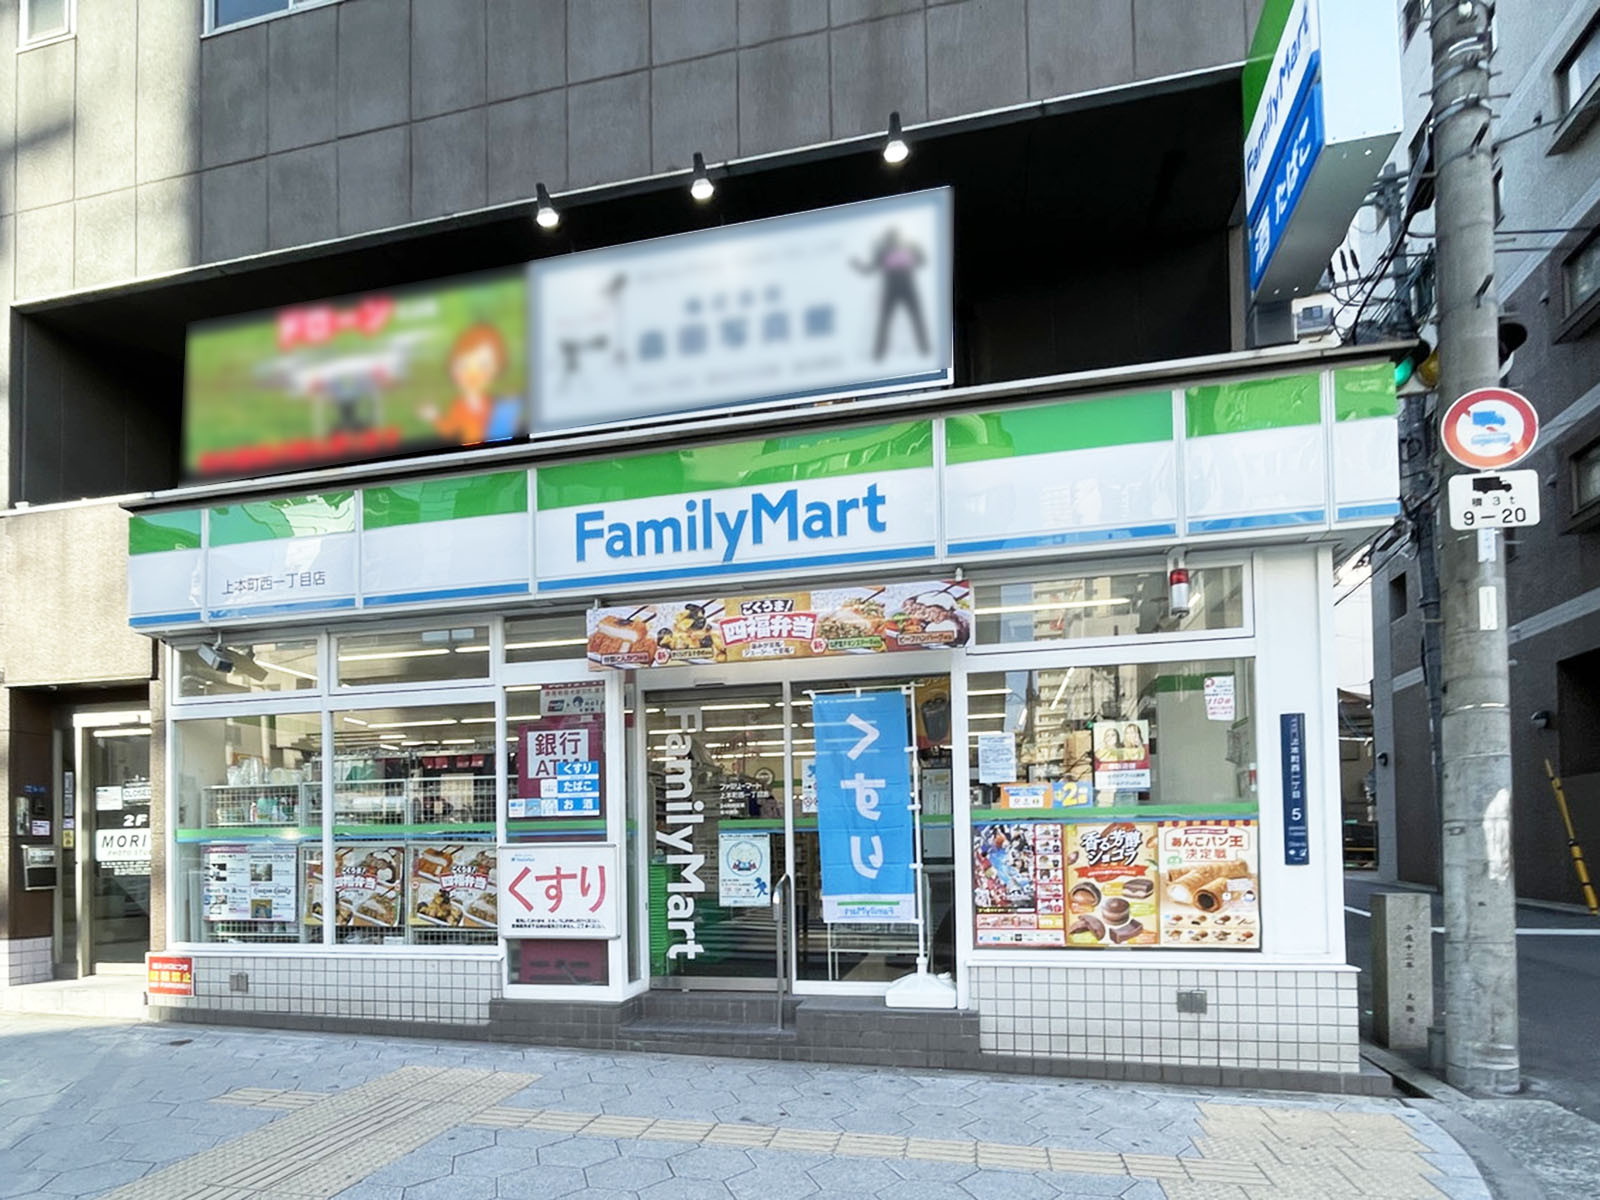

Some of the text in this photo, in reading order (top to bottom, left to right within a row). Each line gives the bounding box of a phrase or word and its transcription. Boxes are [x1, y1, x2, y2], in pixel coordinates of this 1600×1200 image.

[1247, 5, 1308, 187] FamilyMart
[1276, 116, 1311, 225] たばこ
[576, 483, 886, 563] FamilyMart
[221, 571, 326, 595] 上本町西一丁目店
[722, 614, 815, 644] 四福弁当
[535, 732, 581, 756] 銀行
[563, 763, 592, 774] くすり
[563, 781, 592, 792] たばこ
[123, 814, 148, 827] 2F
[1292, 807, 1301, 820] 5
[102, 835, 147, 848] MORI
[656, 707, 705, 960] FamilyMart
[1171, 835, 1243, 848] あんこパン王
[1087, 848, 1138, 867] ショコラ
[508, 866, 606, 913] くすり
